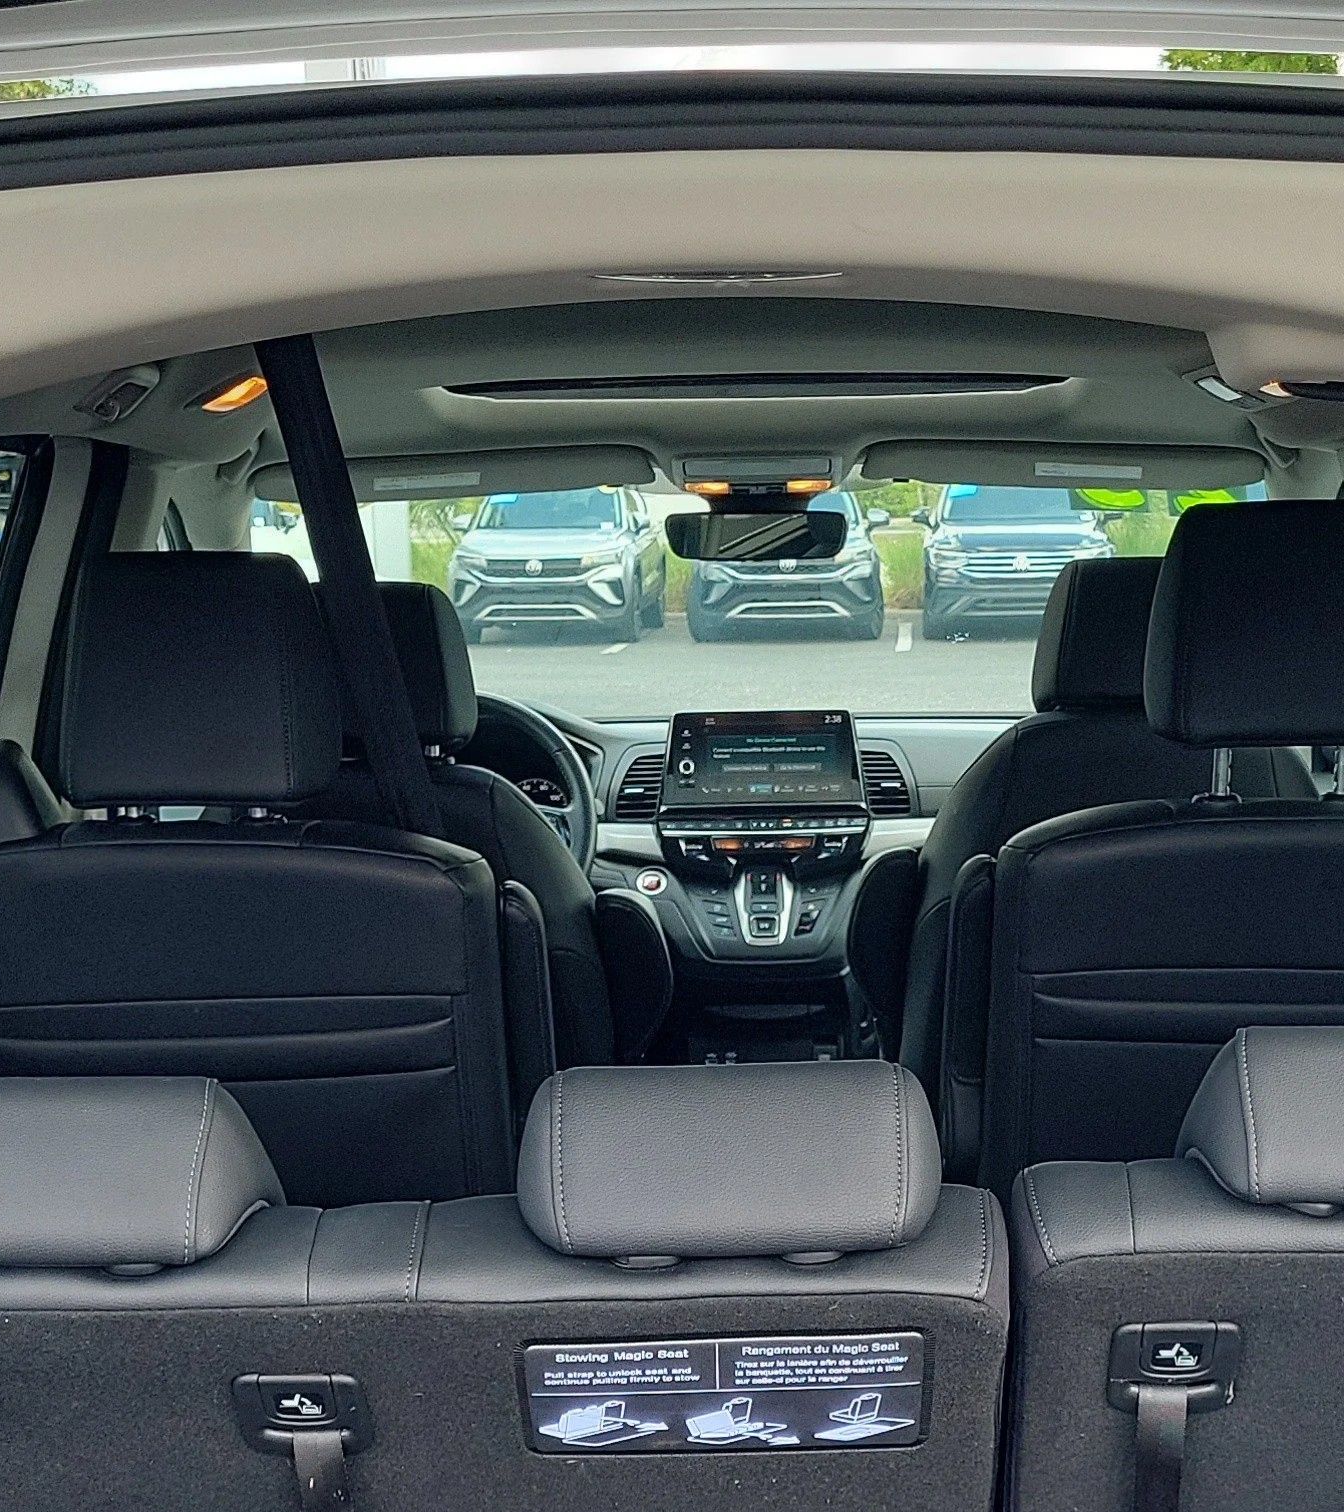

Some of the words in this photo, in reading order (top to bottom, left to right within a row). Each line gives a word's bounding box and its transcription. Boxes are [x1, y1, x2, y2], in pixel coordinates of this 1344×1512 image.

[742, 1344, 811, 1356] Rangement
[814, 1344, 829, 1354] du
[832, 1343, 869, 1355] Magic
[872, 1342, 899, 1352] Seat
[556, 1353, 608, 1364] Stowing
[614, 1350, 653, 1362] Magic
[658, 1349, 689, 1359] Seat
[609, 1369, 642, 1377] unlock
[672, 1367, 692, 1375] and
[592, 1377, 627, 1386] pulling
[629, 1376, 659, 1384] firmly
